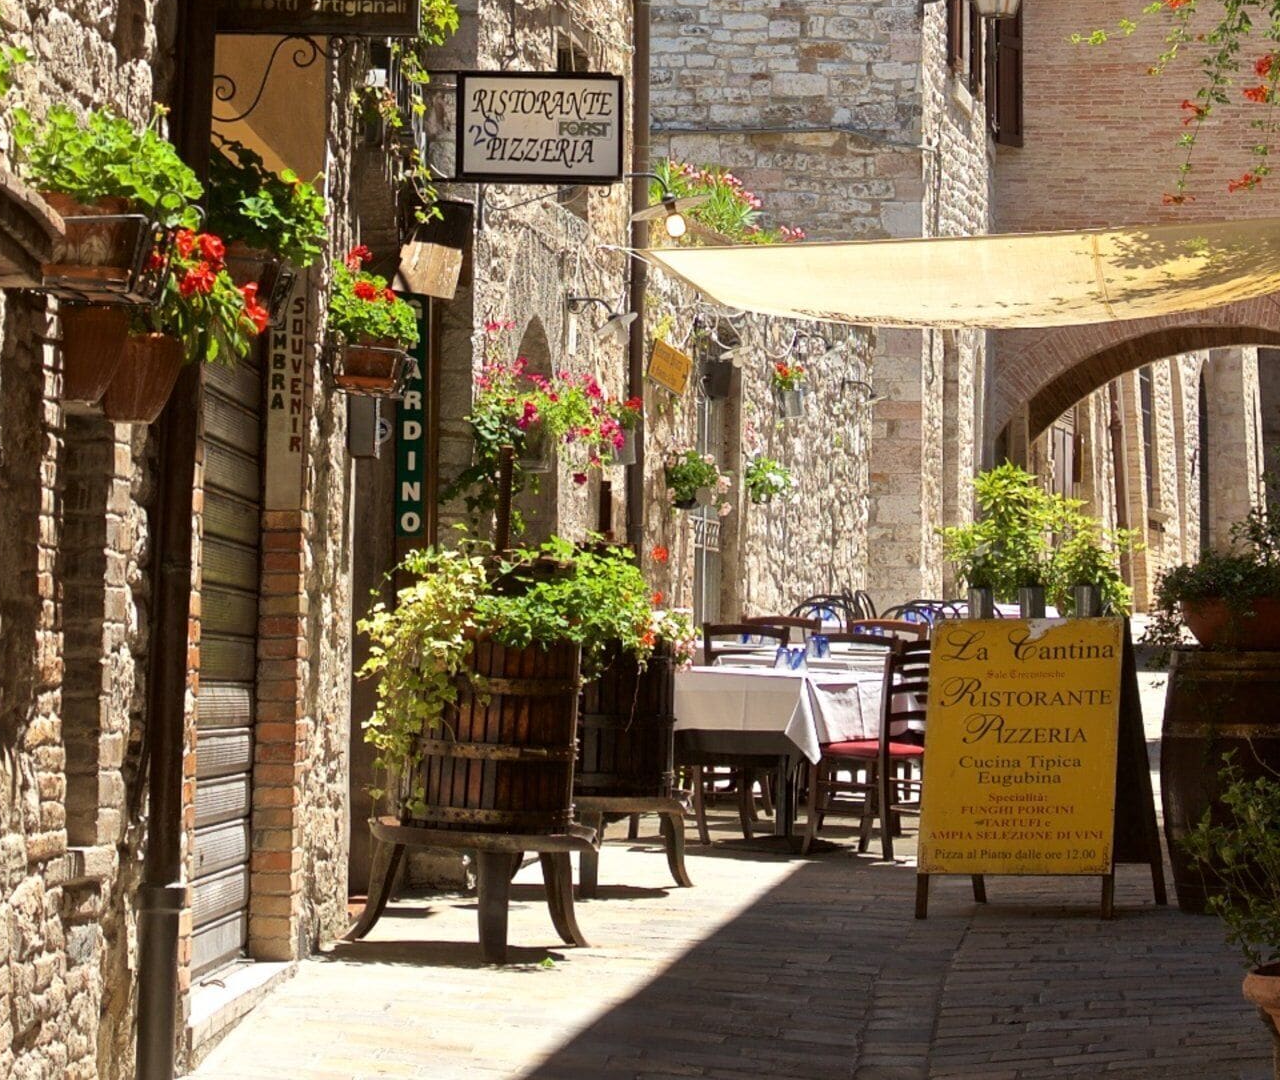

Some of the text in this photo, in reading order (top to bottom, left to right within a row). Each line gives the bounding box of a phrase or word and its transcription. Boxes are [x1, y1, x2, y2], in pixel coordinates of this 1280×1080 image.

[471, 88, 613, 121] RISTORANTE
[558, 120, 612, 138] FORST
[486, 136, 595, 169] PIZZERIA
[289, 296, 305, 453] SOUVENIR
[940, 628, 1115, 663] La Cantina
[940, 676, 1113, 708] RISTORANTE
[962, 713, 1089, 745] PIZZERIA
[959, 754, 1082, 771] Cucina Tipica
[977, 771, 1062, 787] Eugubina
[961, 805, 1075, 815] FUNGHI PORCINI
[983, 818, 1041, 827] TARTUFI
[928, 831, 1104, 841] AMPIA SELEZIONE DI VINI
[934, 849, 1096, 860] Pizza al Piatto dalle ore 12.00
